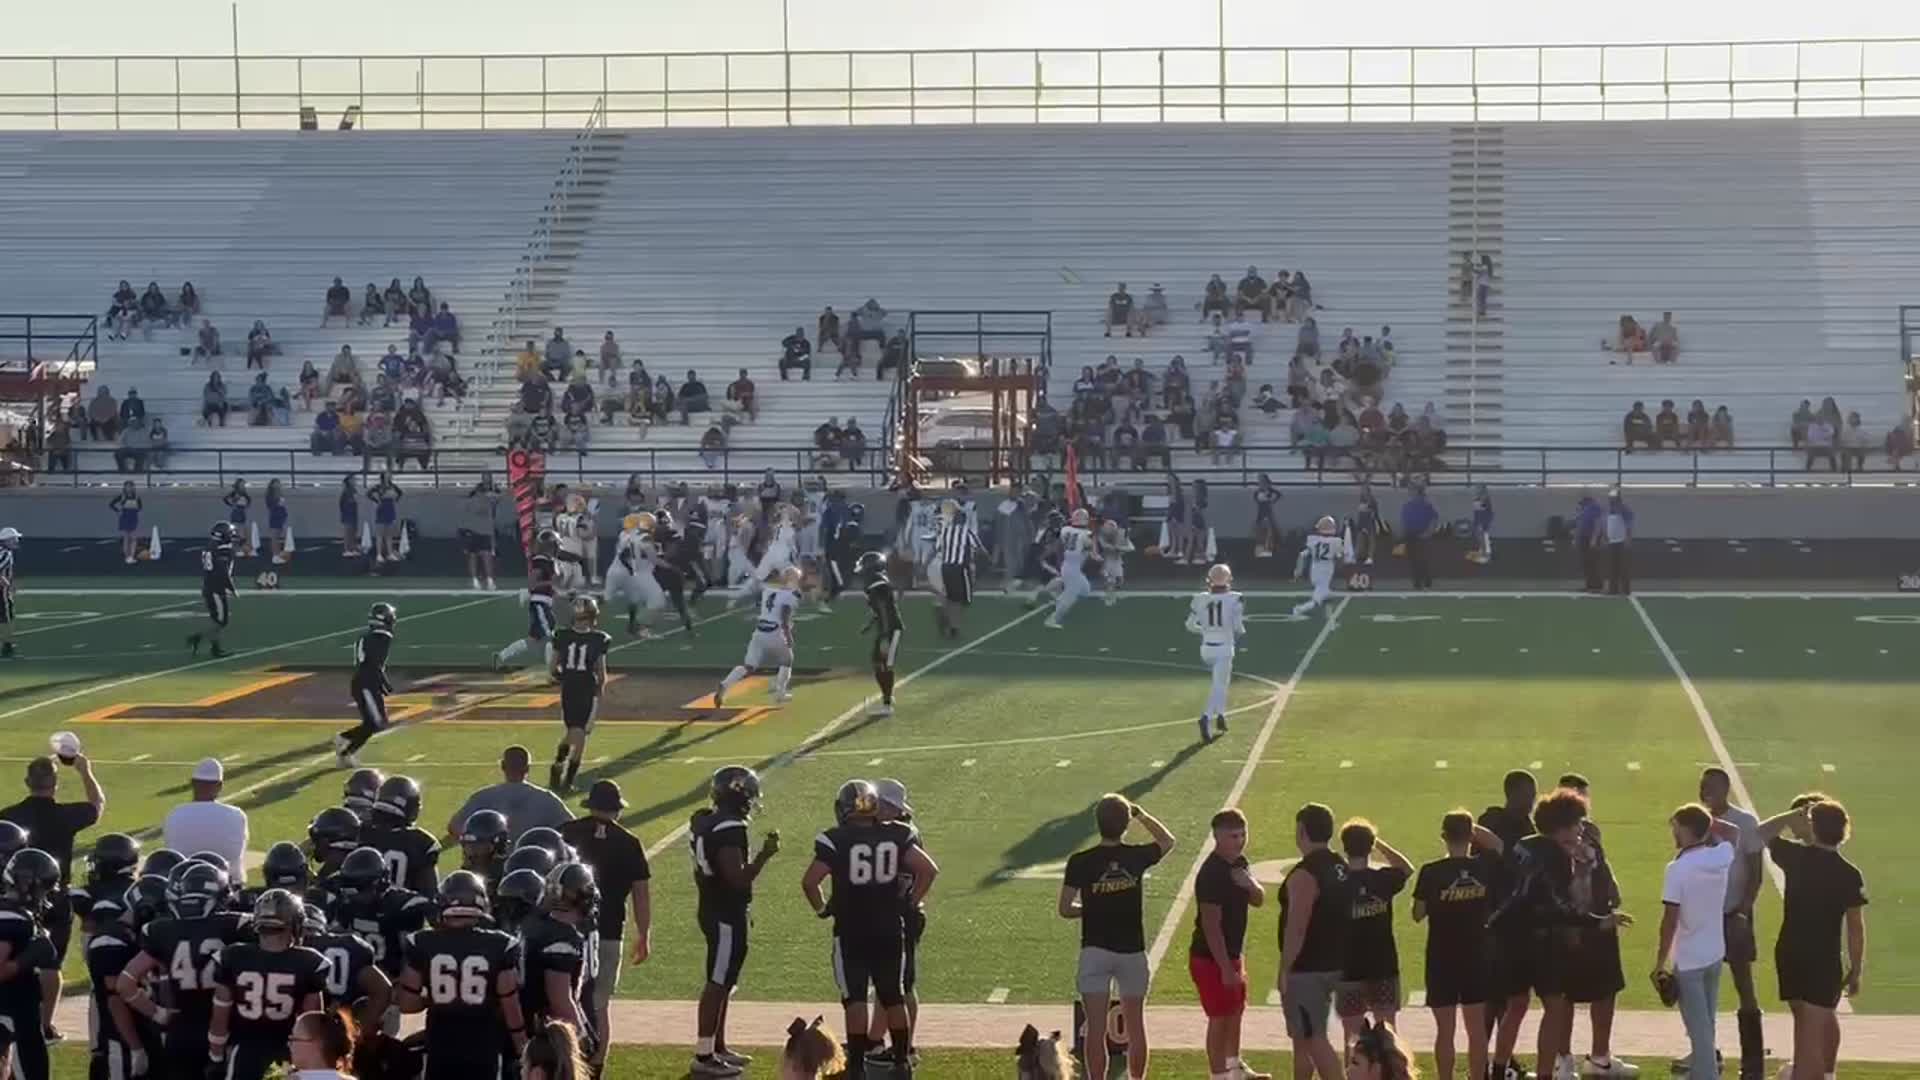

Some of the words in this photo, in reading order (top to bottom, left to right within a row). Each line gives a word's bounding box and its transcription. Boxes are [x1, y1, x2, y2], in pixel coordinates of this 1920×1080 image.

[1314, 541, 1329, 561] 12
[256, 571, 277, 587] 40
[1350, 574, 1369, 589] 40
[1206, 600, 1222, 627] 11
[566, 642, 586, 671] 11
[849, 841, 897, 885] 60
[430, 953, 489, 1006] 66
[236, 971, 296, 1021] 35
